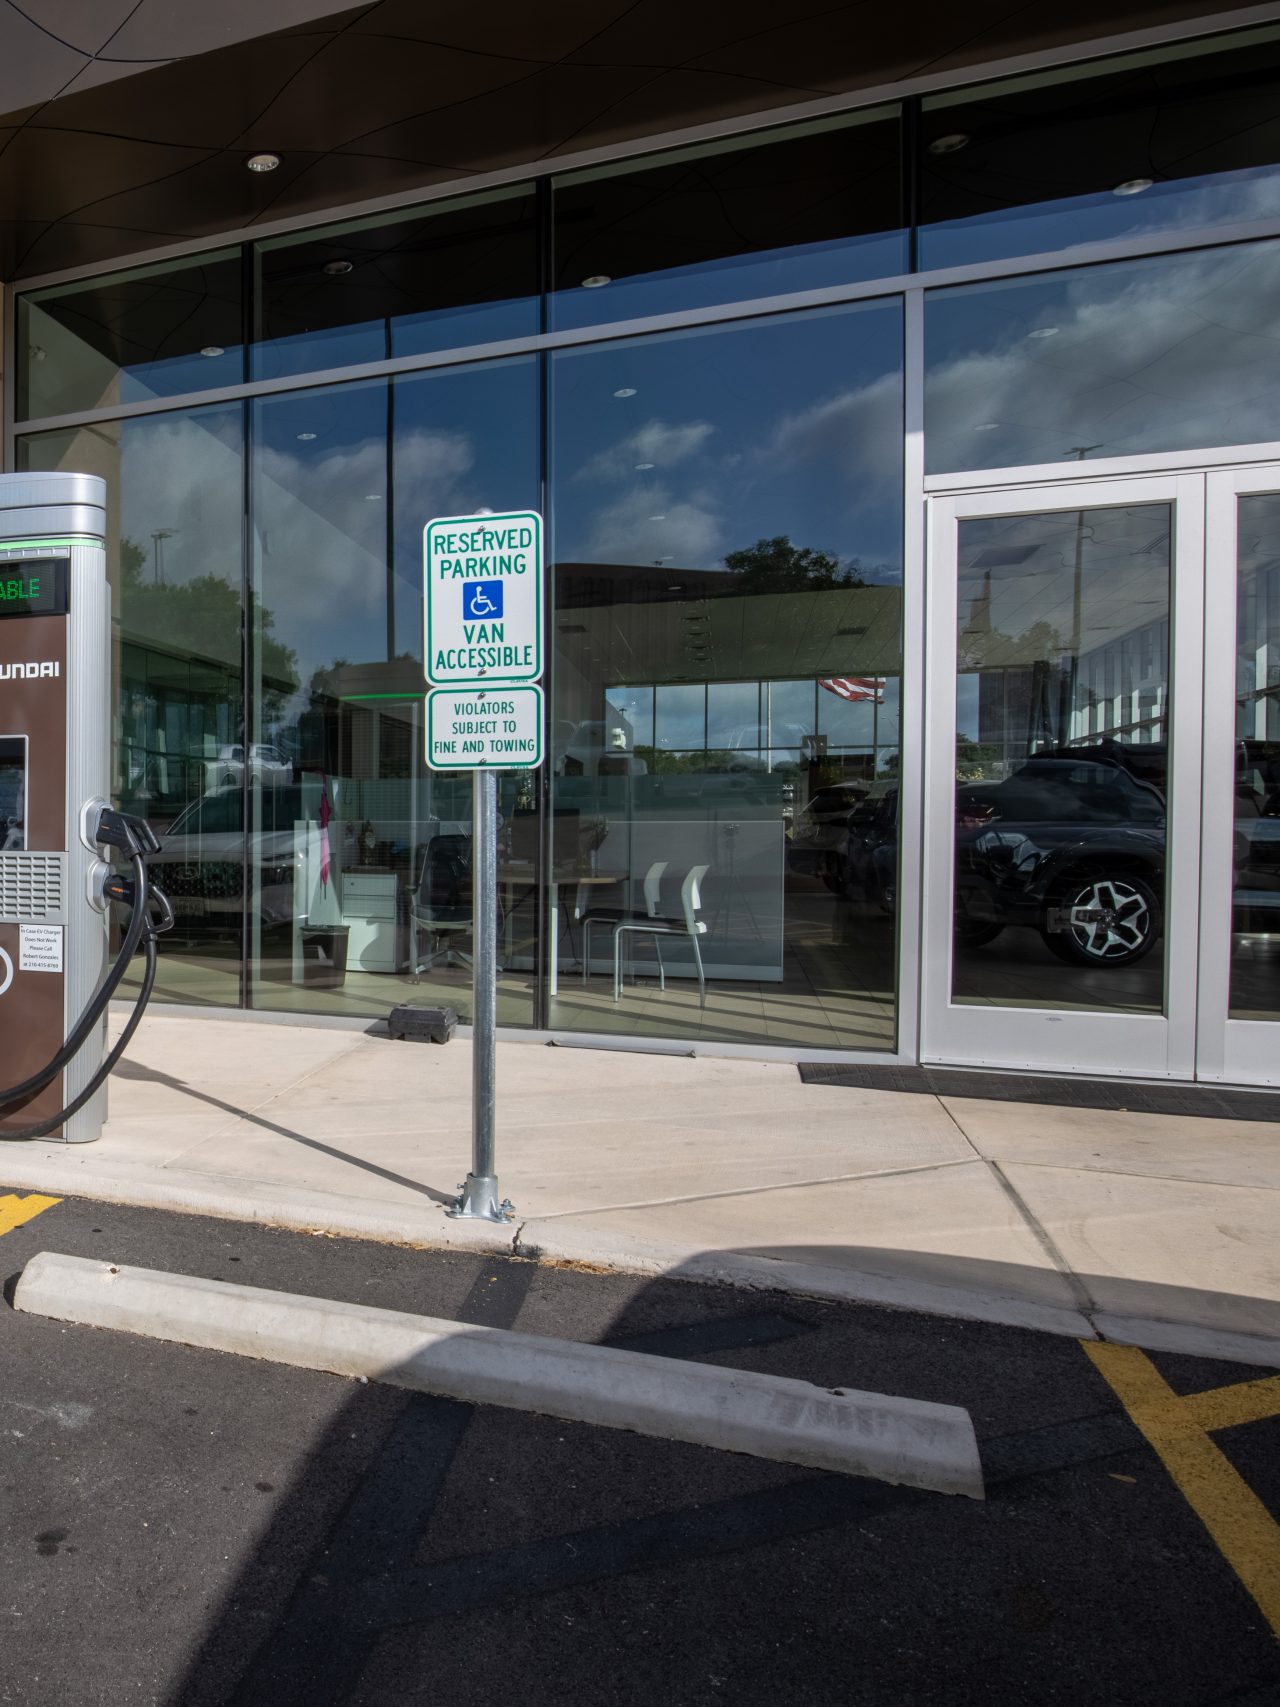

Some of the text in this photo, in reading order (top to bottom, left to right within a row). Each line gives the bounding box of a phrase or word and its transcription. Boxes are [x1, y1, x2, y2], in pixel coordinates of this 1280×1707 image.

[434, 528, 532, 555] RESERVED
[440, 554, 526, 579] PARKING
[463, 623, 504, 644] VAN
[435, 645, 533, 669] ACCESSIBLE
[454, 701, 515, 715] VIOLATORS
[452, 720, 517, 734] SUBJECT TO
[434, 739, 535, 754] FINE AND TOWING
